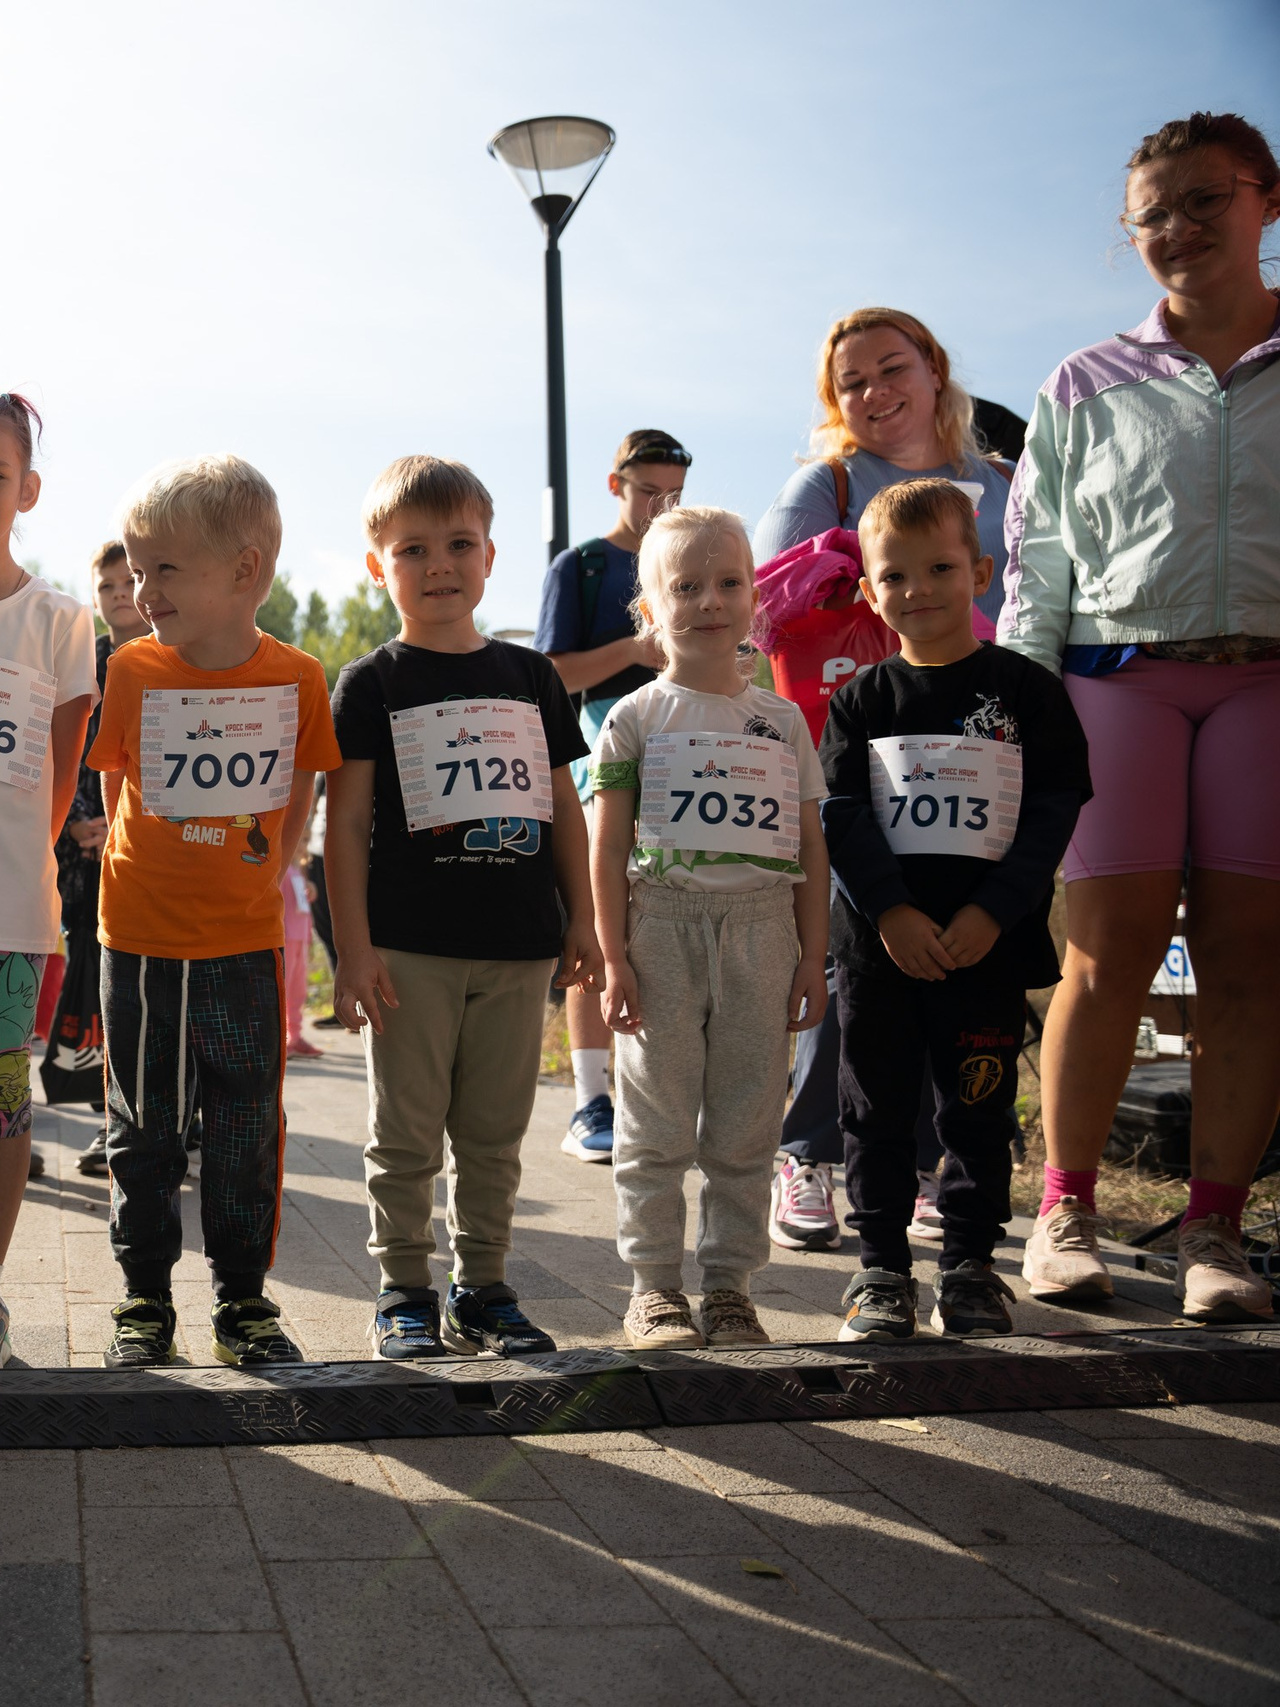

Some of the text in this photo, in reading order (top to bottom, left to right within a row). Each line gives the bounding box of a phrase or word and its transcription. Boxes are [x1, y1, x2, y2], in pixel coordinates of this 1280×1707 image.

[244, 722, 262, 731] НАЦИИ
[483, 730, 499, 738] КРОСС
[164, 749, 279, 789] 7007
[436, 757, 531, 796] 7128
[730, 766, 766, 777] КРОСС НАЦИИ
[938, 768, 978, 777] КРОСС НАЦИИ
[670, 791, 780, 831] 7032
[889, 794, 989, 831] 7013
[182, 823, 226, 847] GAME!
